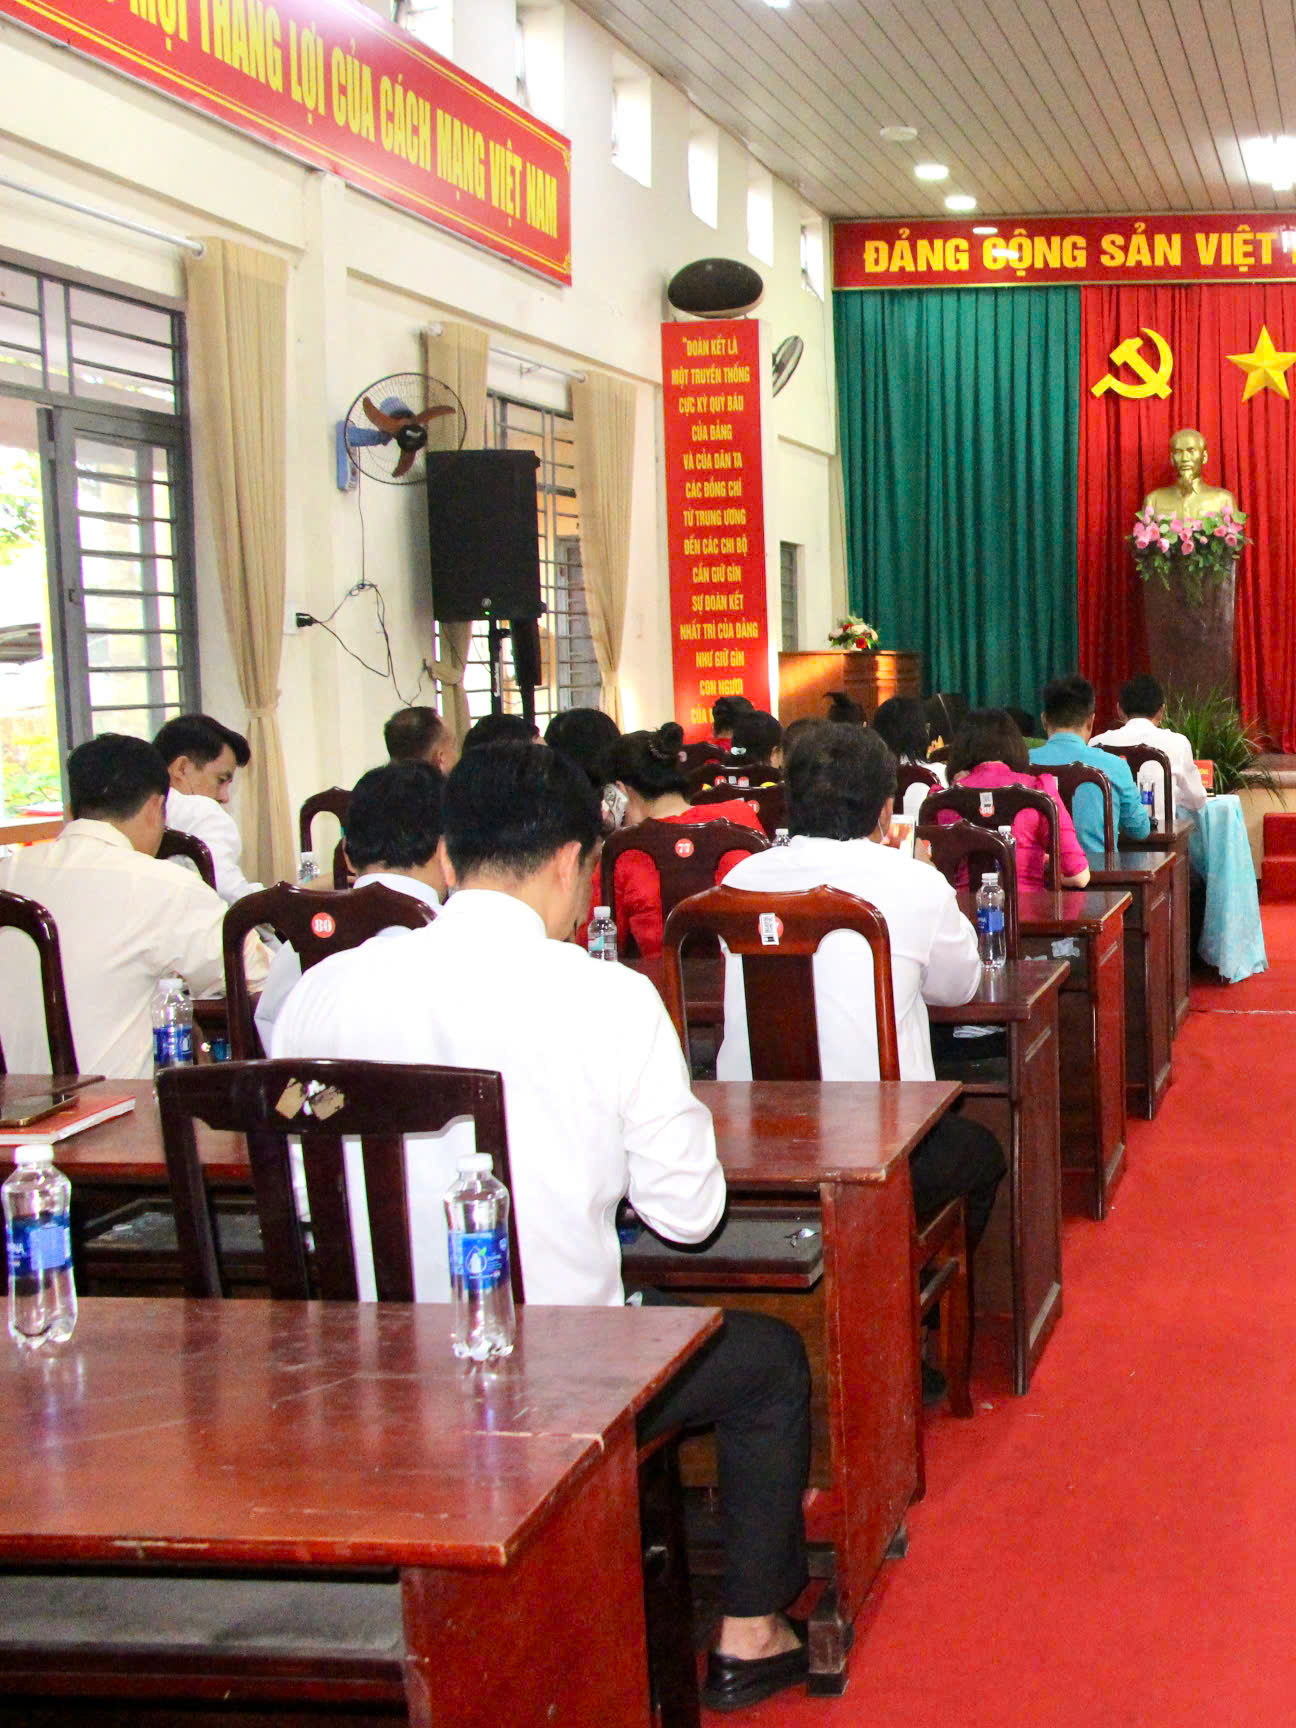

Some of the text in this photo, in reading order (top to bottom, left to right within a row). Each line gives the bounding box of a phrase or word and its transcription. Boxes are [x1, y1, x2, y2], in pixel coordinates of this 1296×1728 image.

[331, 38, 375, 143] CỦA
[380, 73, 431, 172] CÁCH
[437, 108, 485, 200] MẠNG
[489, 139, 523, 227] VIỆT
[526, 162, 557, 239] NAM
[864, 228, 969, 273] ĐẢNG
[981, 229, 1087, 277] CỘNG
[1100, 222, 1182, 268] SẢN
[1197, 225, 1273, 272] VIỆT
